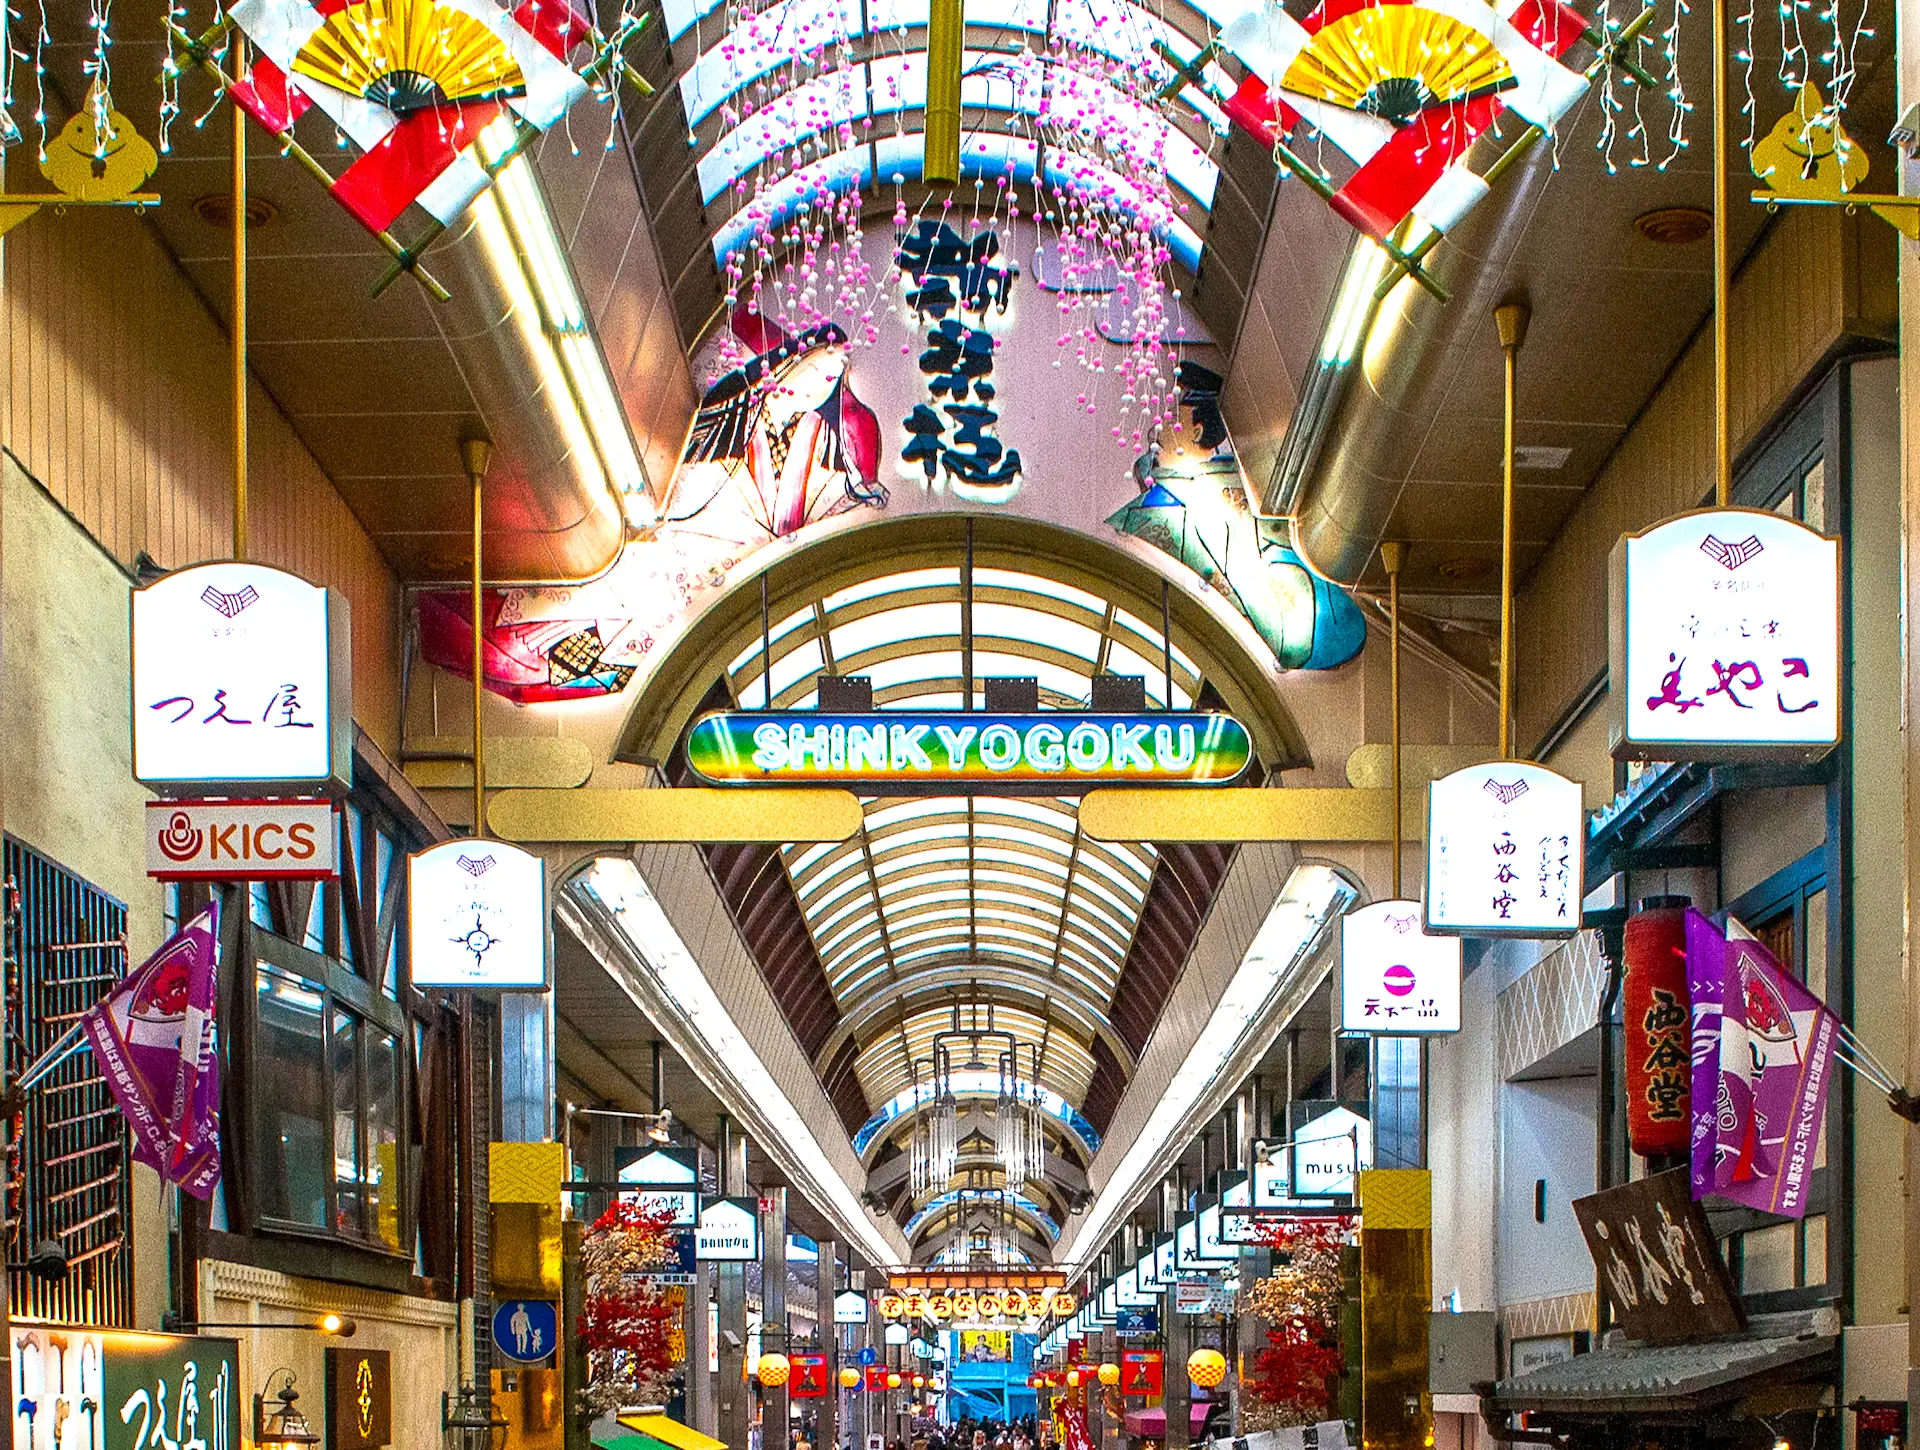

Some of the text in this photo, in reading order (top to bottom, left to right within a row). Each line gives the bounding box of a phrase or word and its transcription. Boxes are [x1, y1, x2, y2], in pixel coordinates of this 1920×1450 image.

[895, 219, 1022, 489] 新京極
[149, 683, 315, 729] つえ屋
[752, 722, 1197, 772] SHINKYOGOKU
[209, 822, 316, 861] KICS
[1493, 831, 1520, 919] 西谷堂
[1643, 987, 1691, 1122] 西谷堂
[1306, 1160, 1373, 1175] musub
[883, 1293, 1073, 1314] 京まちなか新京極
